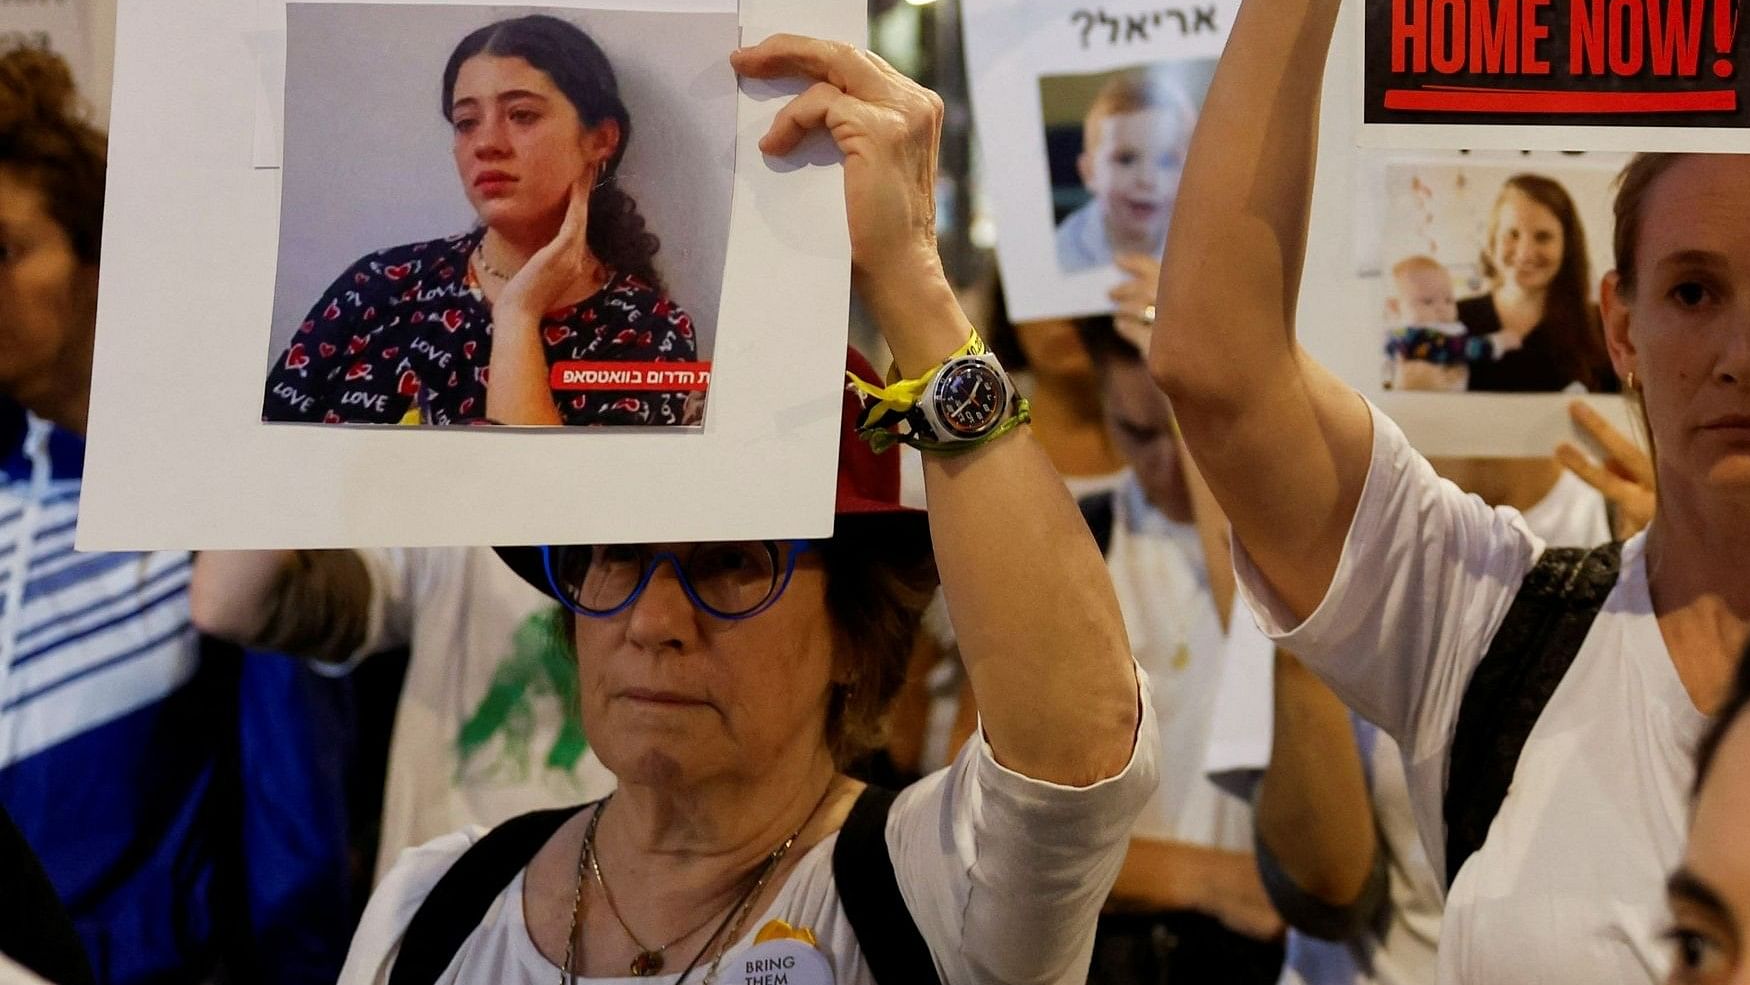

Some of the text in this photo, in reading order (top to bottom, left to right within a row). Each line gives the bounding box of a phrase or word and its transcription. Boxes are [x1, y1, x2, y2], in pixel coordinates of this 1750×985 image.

[1071, 4, 1218, 48] אריאל?
[410, 336, 453, 368] LOVE
[563, 370, 642, 384] בוואטסאפ
[646, 371, 695, 385] הדרום
[272, 380, 315, 413] LOVE
[341, 390, 390, 413] LOVE
[745, 956, 796, 974] BRING
[745, 973, 788, 985] THEM
